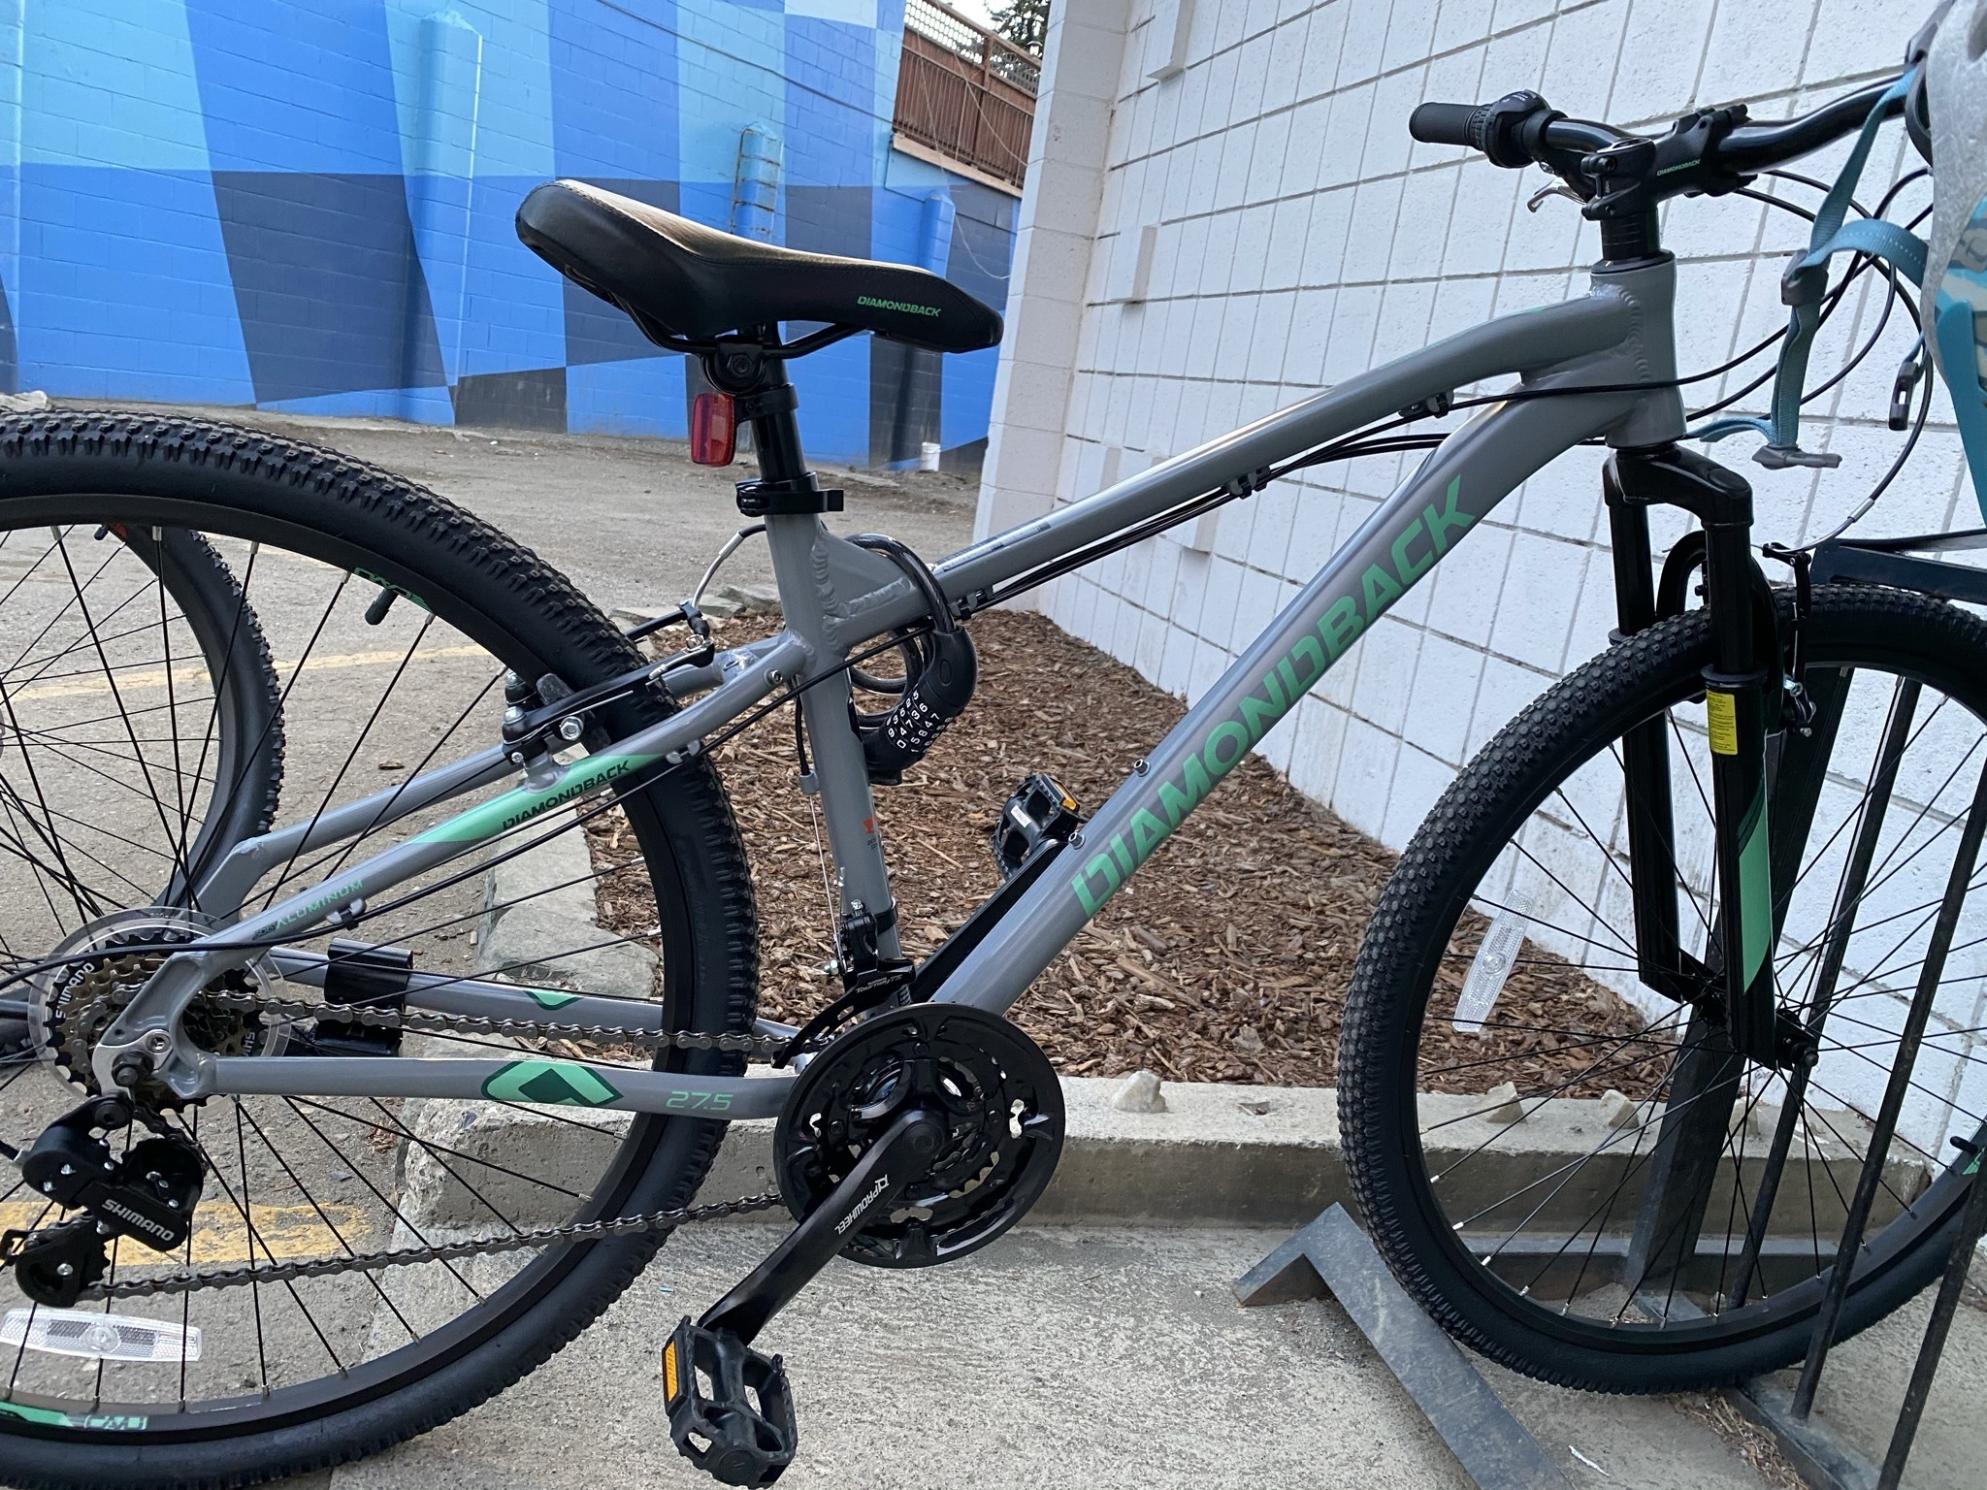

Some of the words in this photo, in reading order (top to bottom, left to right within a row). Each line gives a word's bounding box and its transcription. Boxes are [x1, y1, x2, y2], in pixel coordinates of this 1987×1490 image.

[857, 295, 942, 317] DIAMONDBACK
[1071, 475, 1477, 918] DIAMONDBACK
[502, 760, 630, 831] DIAMONDBACK
[276, 880, 364, 930] ALUMINUM
[665, 1090, 734, 1111] 27.5
[101, 1198, 175, 1241] SHIMANO
[834, 1182, 880, 1235] PROWHEEL
